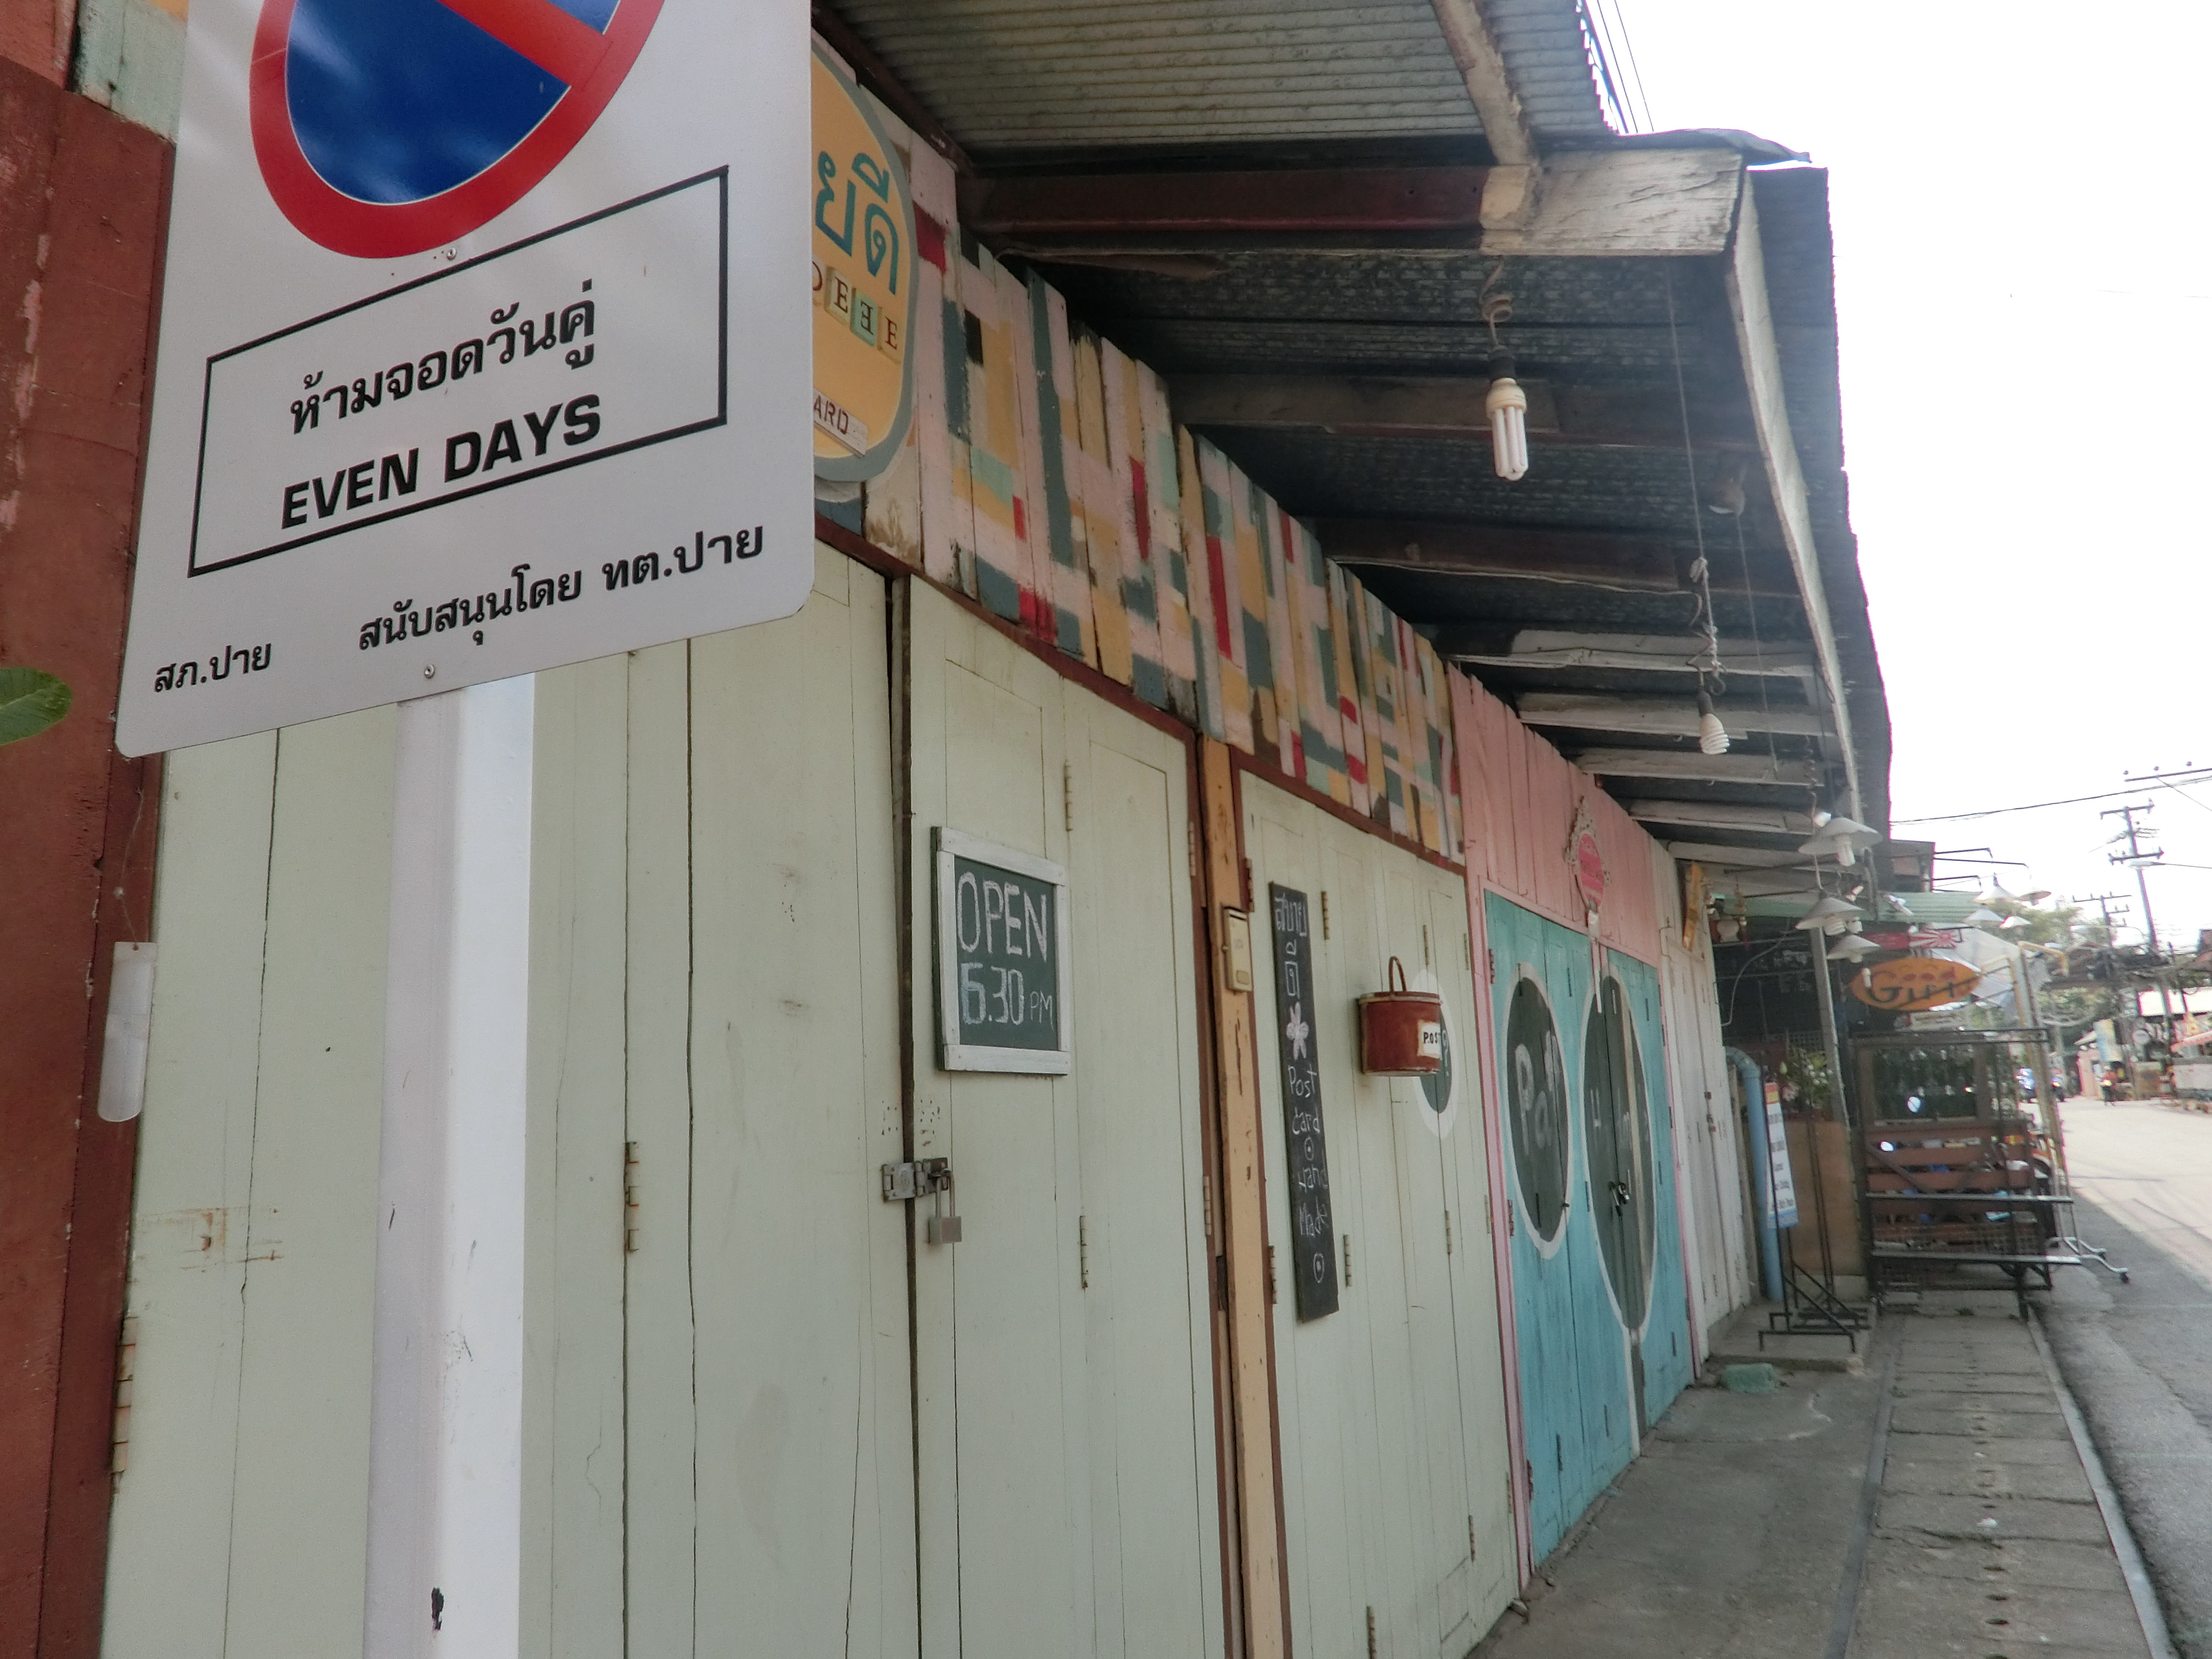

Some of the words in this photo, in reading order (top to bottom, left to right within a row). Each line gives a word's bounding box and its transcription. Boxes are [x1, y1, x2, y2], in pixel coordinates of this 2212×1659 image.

[290, 278, 595, 434] ห้ามจอดวันคู่
[281, 447, 419, 529] EVEN
[444, 394, 601, 483] DAYS
[359, 563, 582, 650] สนับสนุนโดย
[601, 526, 763, 591] ทต.ปาย
[155, 643, 271, 693] สภ.ปาย
[957, 871, 1047, 962] OPEN
[961, 962, 1024, 1026] 6.30
[1030, 989, 1054, 1031] PM
[1287, 1063, 1318, 1098] Post
